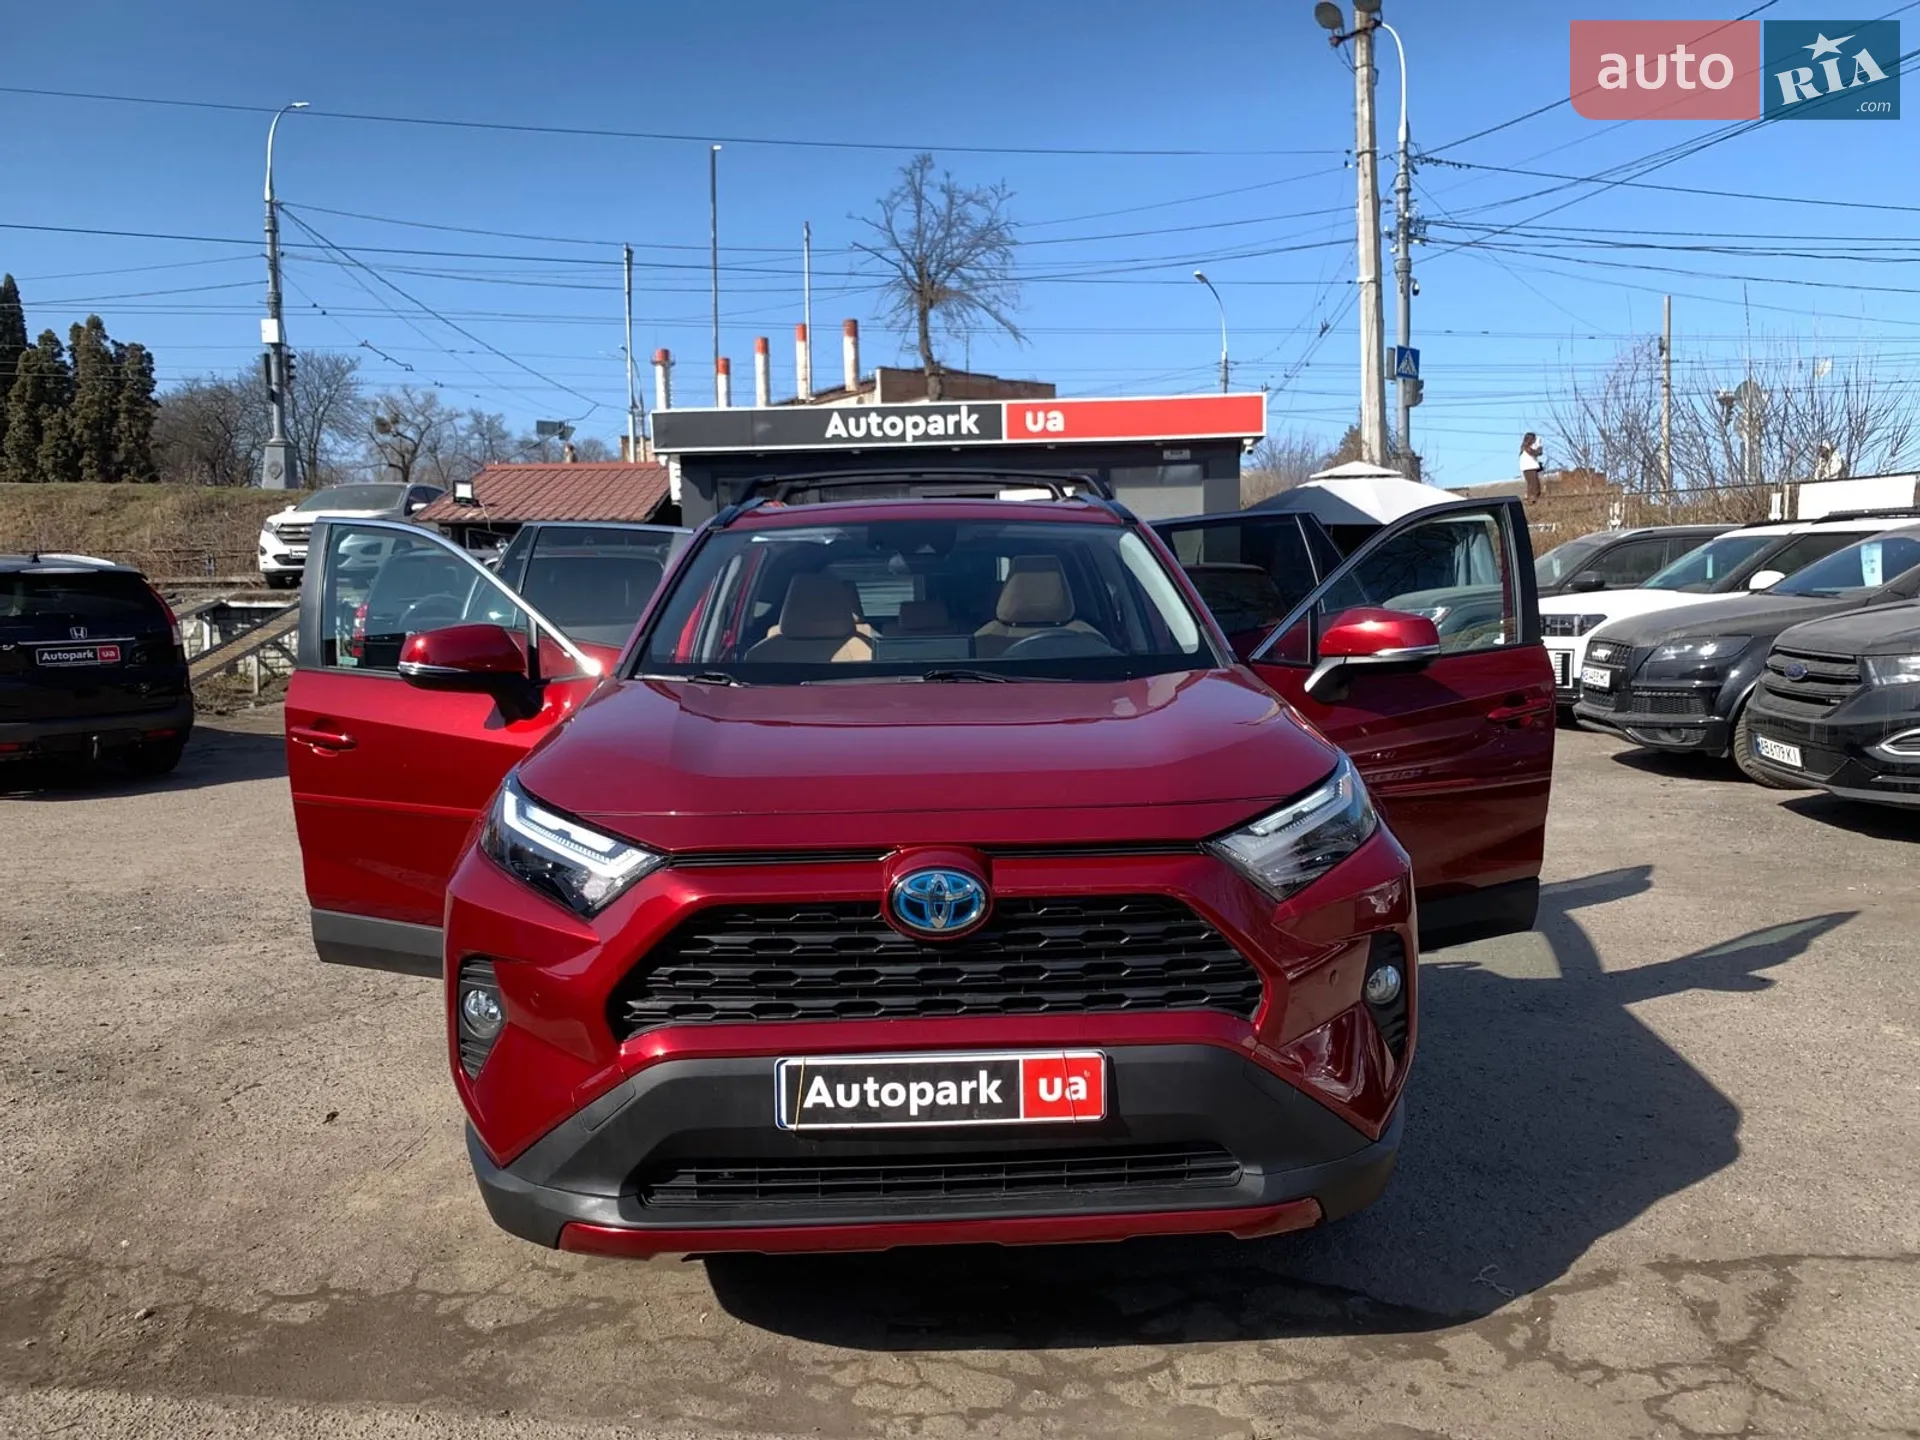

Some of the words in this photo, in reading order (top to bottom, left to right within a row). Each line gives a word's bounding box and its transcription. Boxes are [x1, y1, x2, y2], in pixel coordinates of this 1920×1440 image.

[824, 405, 980, 442] Autopark
[1025, 409, 1065, 433] ua
[41, 649, 95, 661] Autopark
[101, 649, 116, 658] ua
[802, 1070, 1003, 1116] Autopark
[1037, 1074, 1088, 1103] ua
